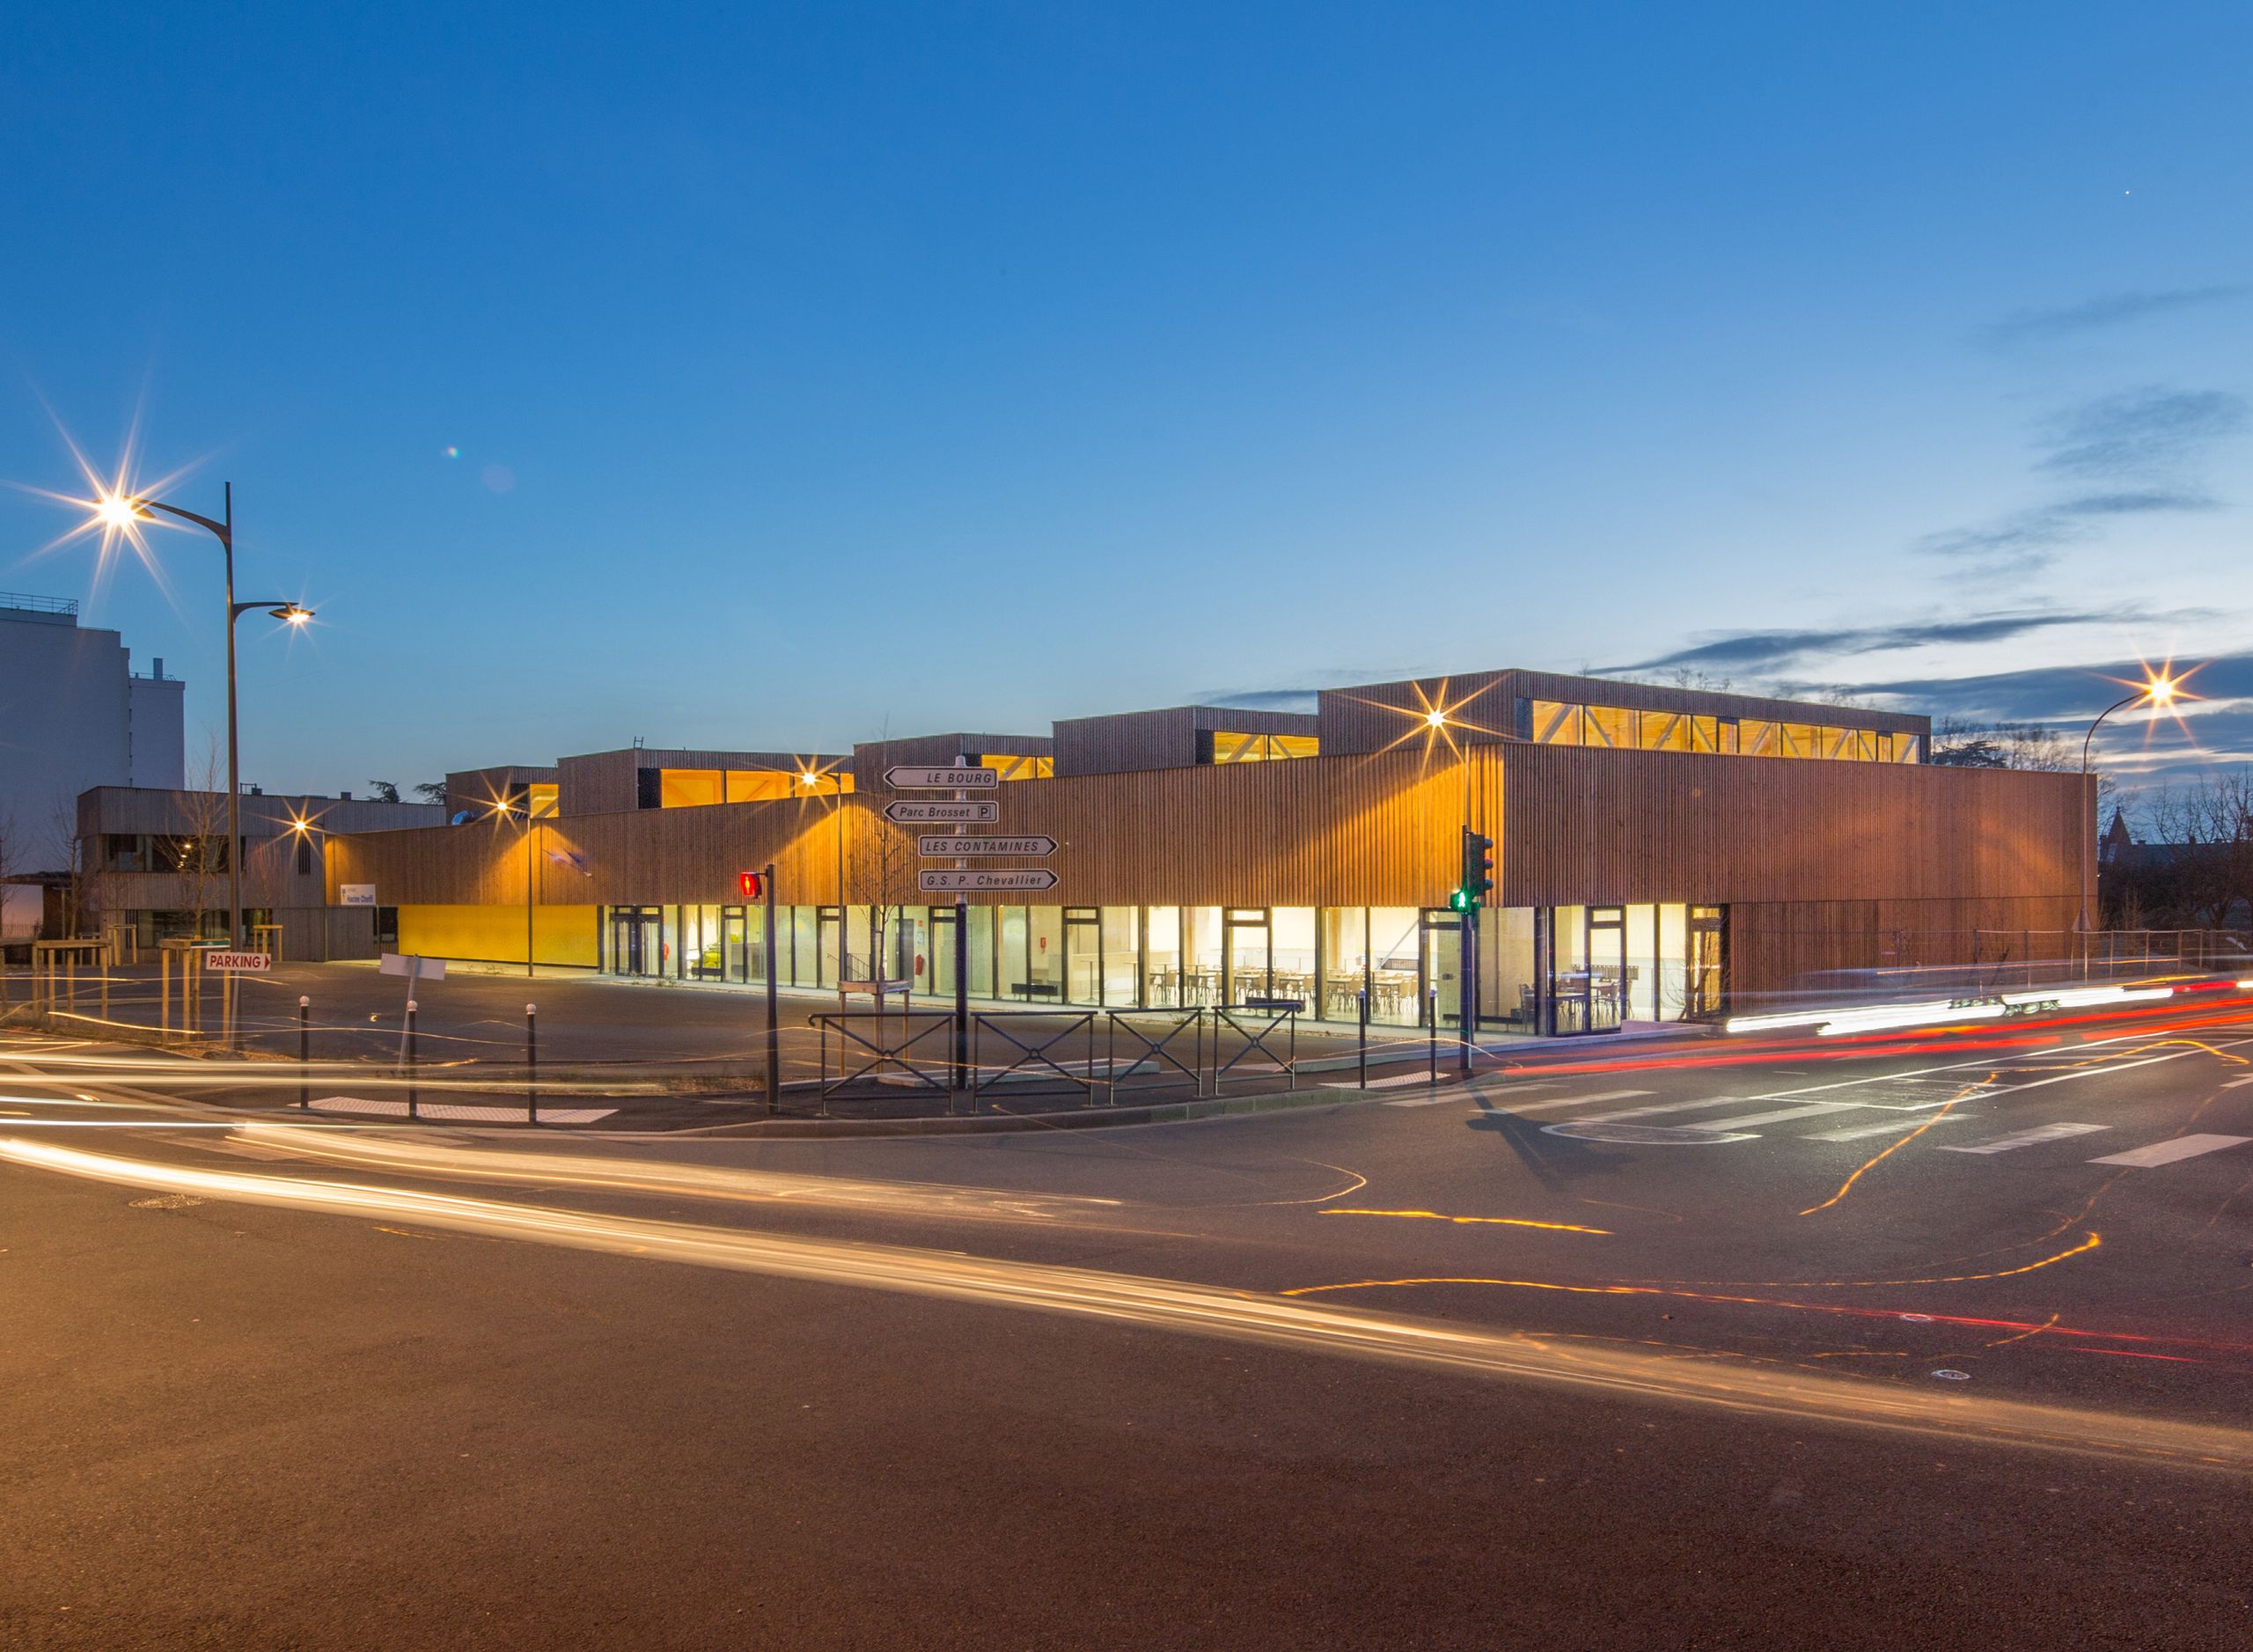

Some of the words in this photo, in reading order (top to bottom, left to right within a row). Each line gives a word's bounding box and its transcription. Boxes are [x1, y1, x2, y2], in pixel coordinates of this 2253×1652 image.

[927, 774, 941, 782] LE
[947, 774, 992, 783] BOURG
[899, 807, 924, 817] Parc
[928, 807, 970, 818] Brosset
[980, 807, 989, 817] P
[926, 841, 948, 852] LES
[955, 841, 1039, 852] CONTAMINES
[927, 876, 951, 885] G.S.
[977, 875, 1043, 885] Chevallier
[209, 955, 261, 968] PARKING
